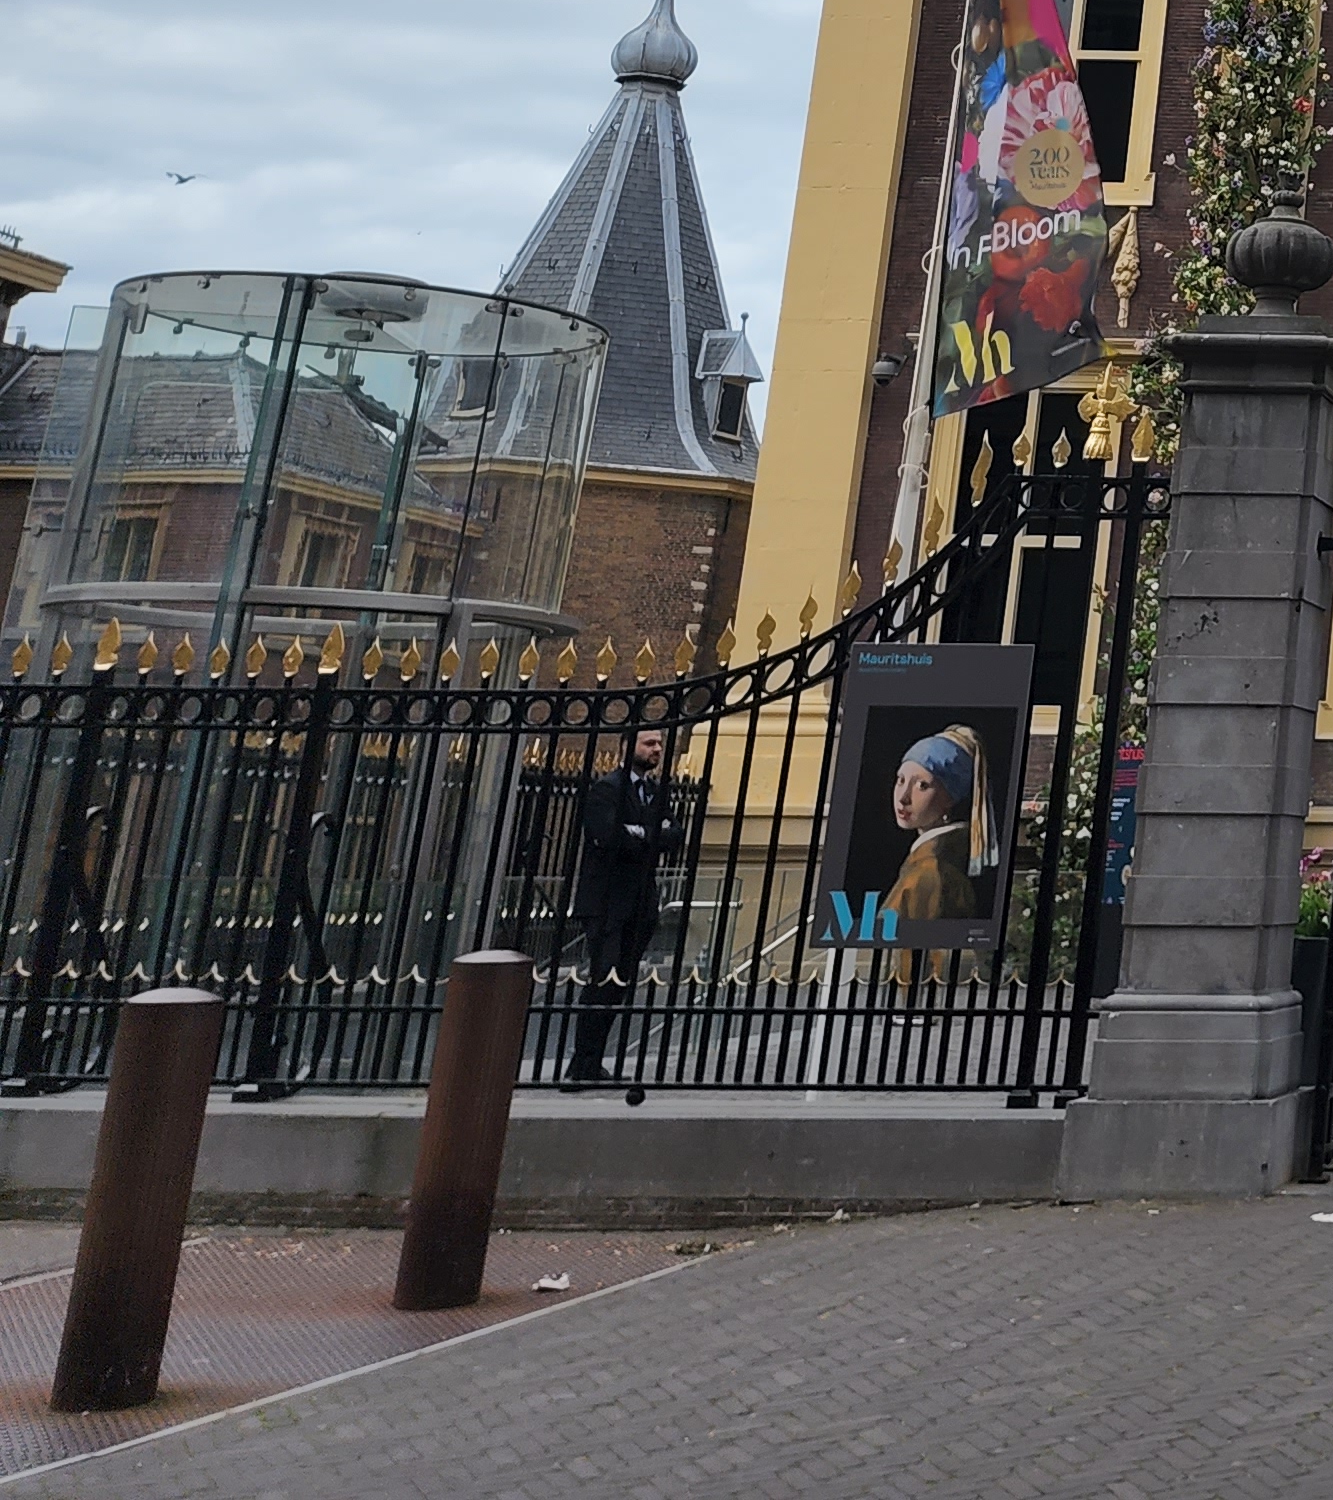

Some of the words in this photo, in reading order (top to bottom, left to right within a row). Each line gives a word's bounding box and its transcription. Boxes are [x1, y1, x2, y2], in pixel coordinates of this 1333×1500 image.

[1029, 146, 1070, 165] 200
[992, 209, 1081, 253] Bloom
[858, 651, 933, 665] Mauritshuis
